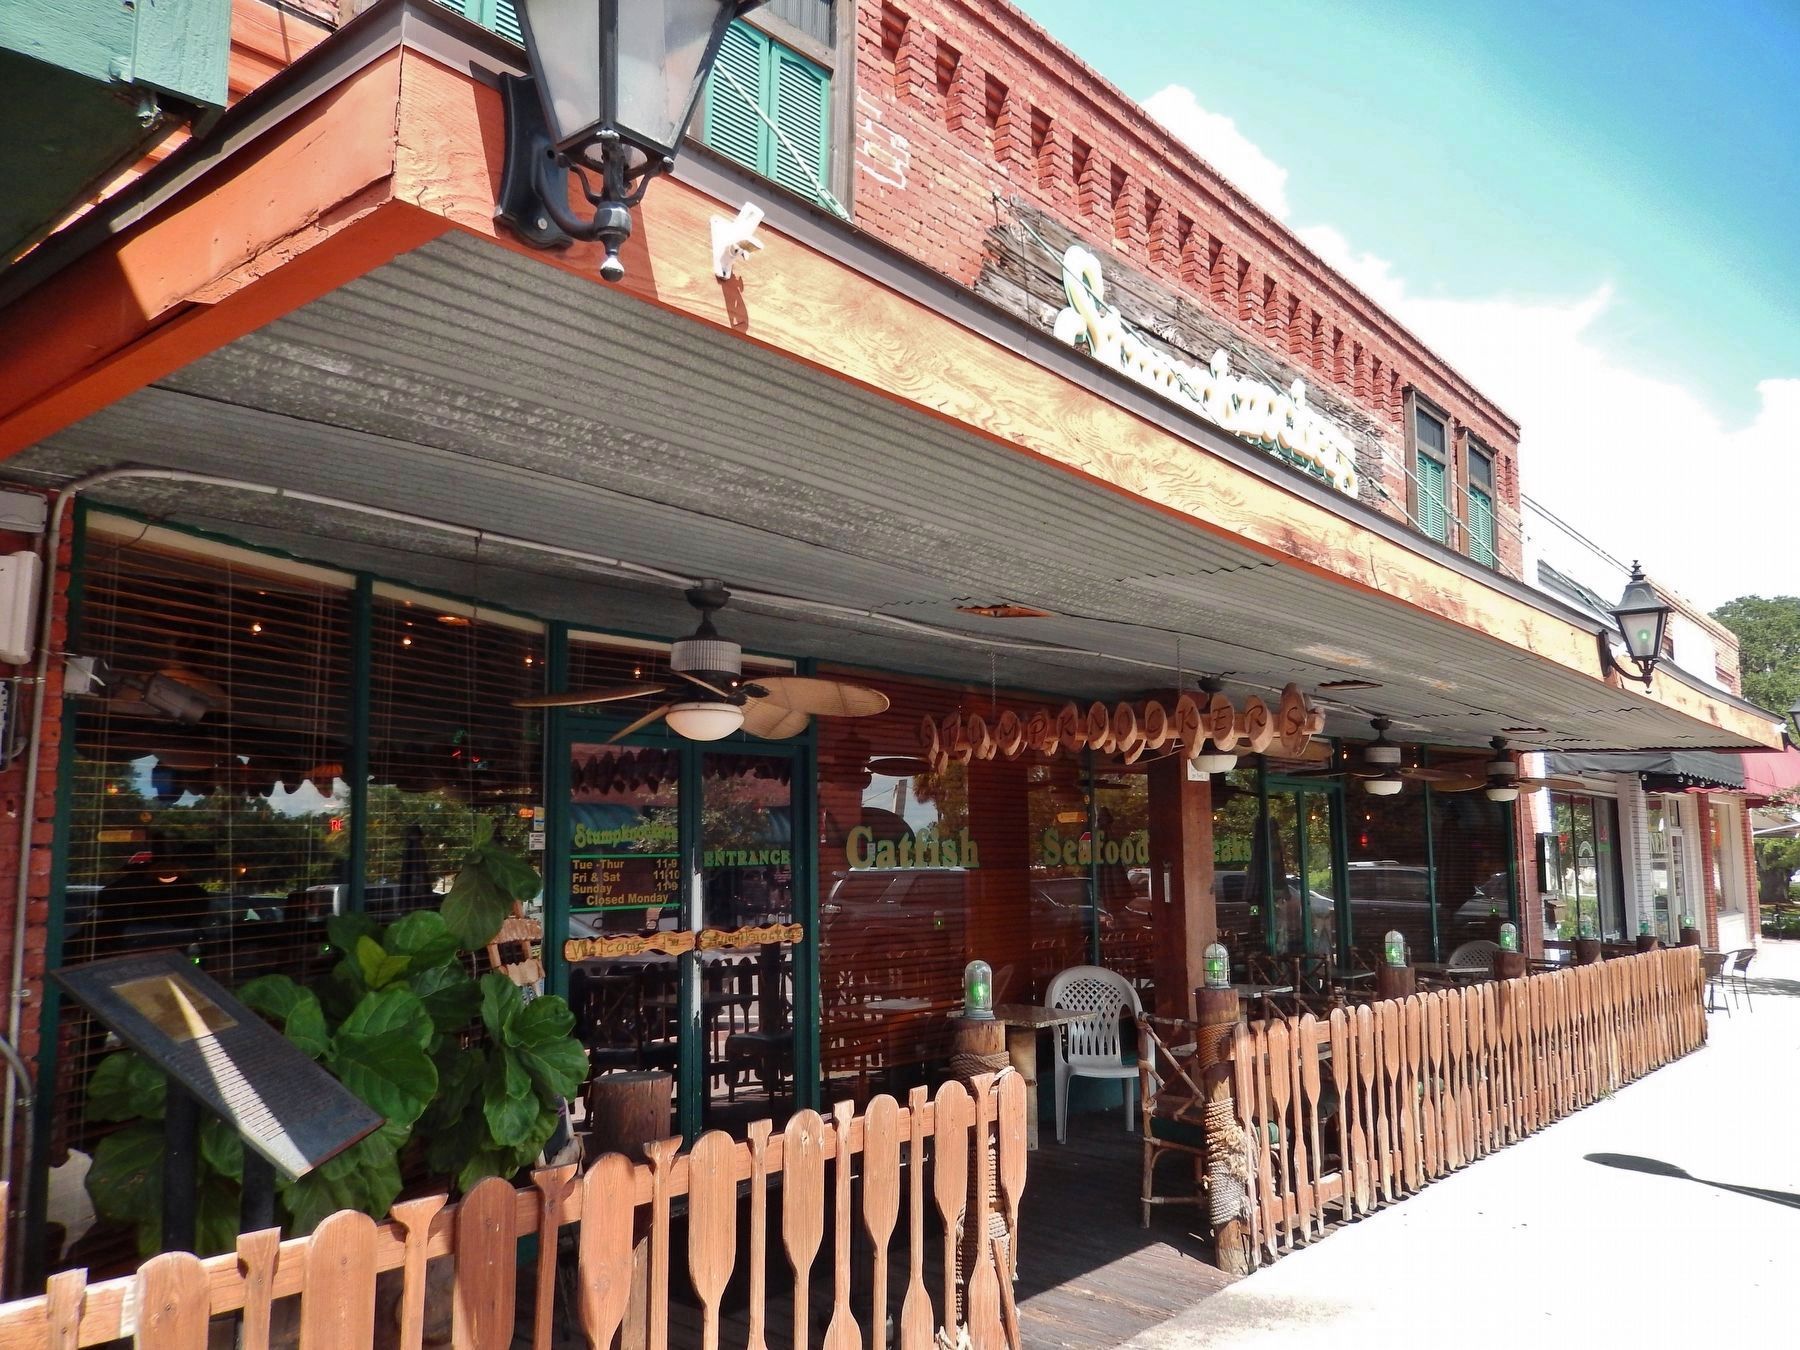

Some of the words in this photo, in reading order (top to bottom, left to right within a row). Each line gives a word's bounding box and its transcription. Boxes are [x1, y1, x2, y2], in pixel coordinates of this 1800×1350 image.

[846, 825, 980, 869] Catfish
[1042, 828, 1150, 866] Seafood
[703, 849, 791, 867] ENTRANCE
[572, 860, 593, 870] Tue
[572, 873, 587, 883] Fri
[590, 872, 599, 882] &
[602, 871, 621, 882] Sat
[572, 884, 613, 895] Sunday
[586, 894, 625, 906] Closed
[627, 893, 669, 904] Monday
